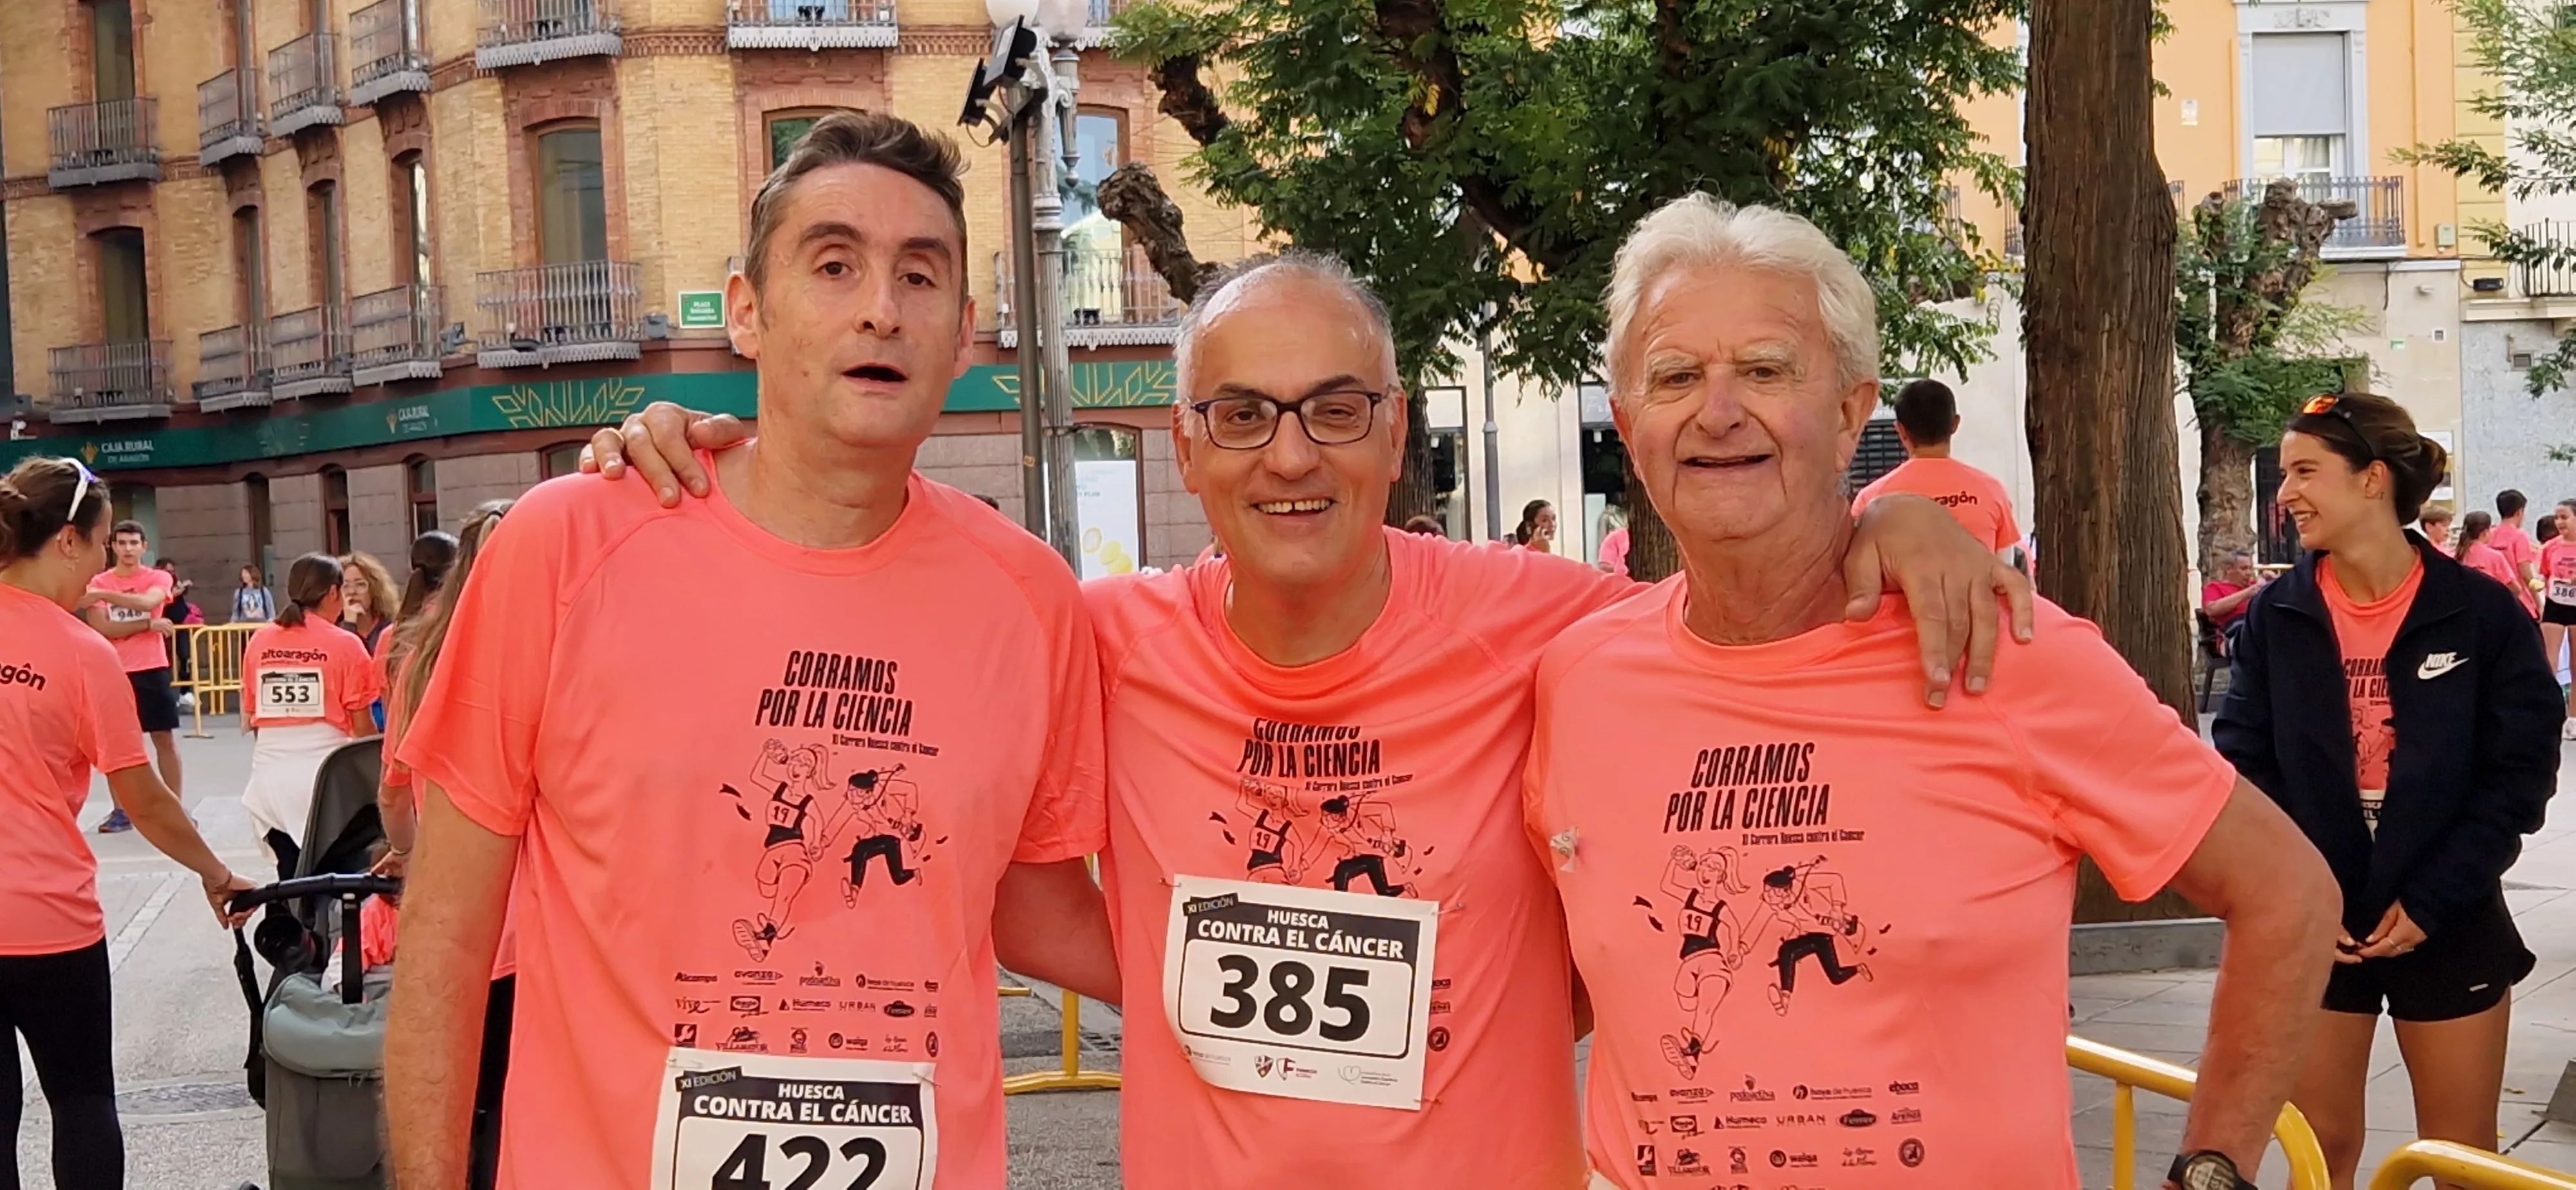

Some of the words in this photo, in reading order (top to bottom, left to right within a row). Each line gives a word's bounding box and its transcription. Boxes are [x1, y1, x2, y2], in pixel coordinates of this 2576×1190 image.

[101, 441, 124, 453] CAJA
[2425, 652, 2457, 668] NIKE
[784, 650, 897, 695] CORRAMOS
[272, 685, 310, 703] 553
[2354, 678, 2366, 698] LA
[755, 688, 800, 727] POR
[803, 691, 828, 728] LA
[833, 693, 913, 736] CIENCIA
[1236, 739, 1274, 777] POR
[1278, 744, 1297, 778] LA
[1303, 739, 1380, 778] CIENCIA
[1691, 742, 1815, 788] CORRAMOS
[773, 806, 790, 824] 19
[1663, 791, 1707, 834] POR
[1710, 789, 1736, 831] LA
[1741, 784, 1830, 829] CIENCIA
[1256, 831, 1271, 849] 19
[1188, 904, 1197, 914] XI
[1198, 896, 1234, 912] EDICIÓN
[1267, 909, 1329, 930] HUESCA
[1687, 913, 1702, 932] 19
[1198, 919, 1280, 945] CONTRA
[1286, 930, 1309, 949] EL
[1315, 930, 1404, 959] CÁNCER
[1209, 954, 1370, 1043] 385
[680, 1079, 691, 1088] XI
[694, 1071, 736, 1088] EDICIÓN
[778, 1083, 845, 1100] HUESCA
[694, 1095, 793, 1121] CONTRA
[799, 1104, 825, 1122] EL
[831, 1100, 913, 1124] CÁNCER
[1776, 1115, 1826, 1126] URBAN
[711, 1133, 887, 1190] 422
